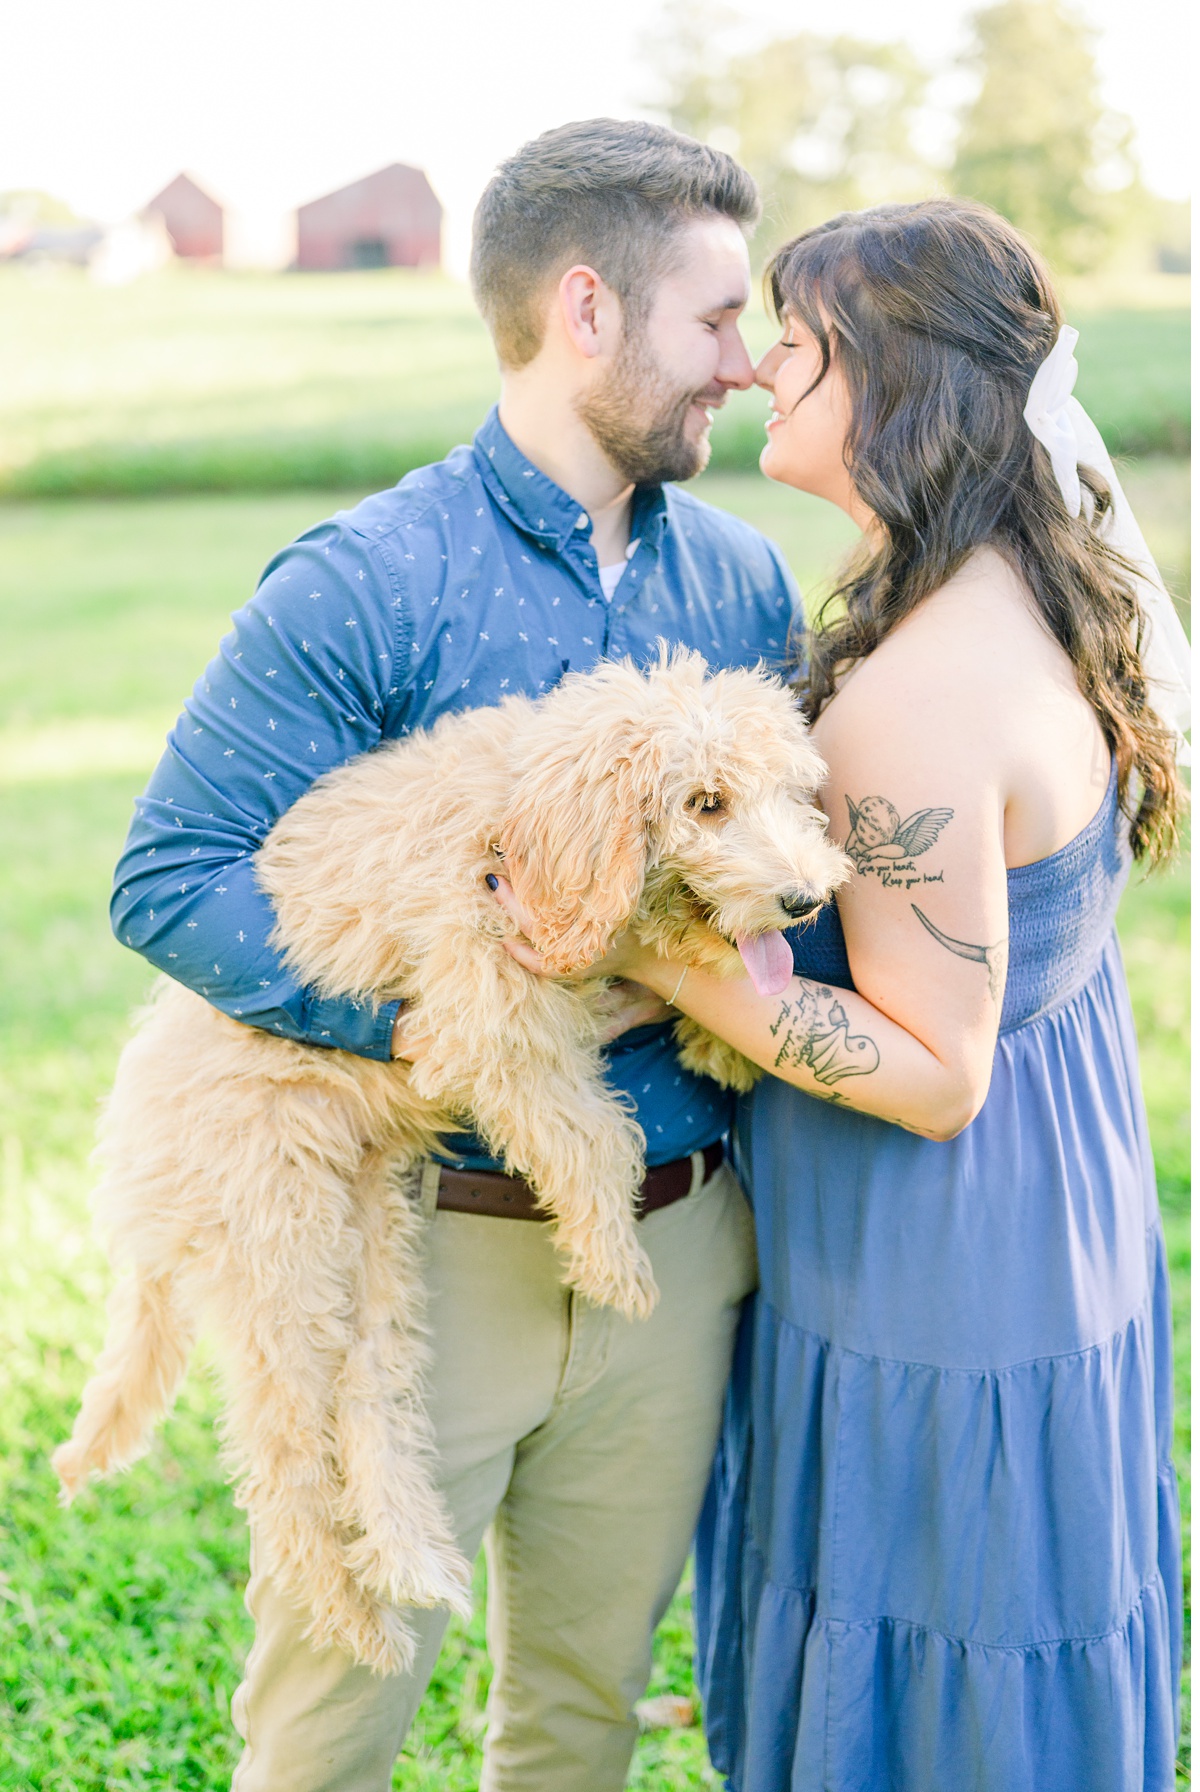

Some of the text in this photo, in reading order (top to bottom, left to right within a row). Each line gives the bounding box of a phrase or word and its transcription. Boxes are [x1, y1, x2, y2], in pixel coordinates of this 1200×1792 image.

[876, 866, 890, 877] your
[882, 870, 944, 889] Keep your head
